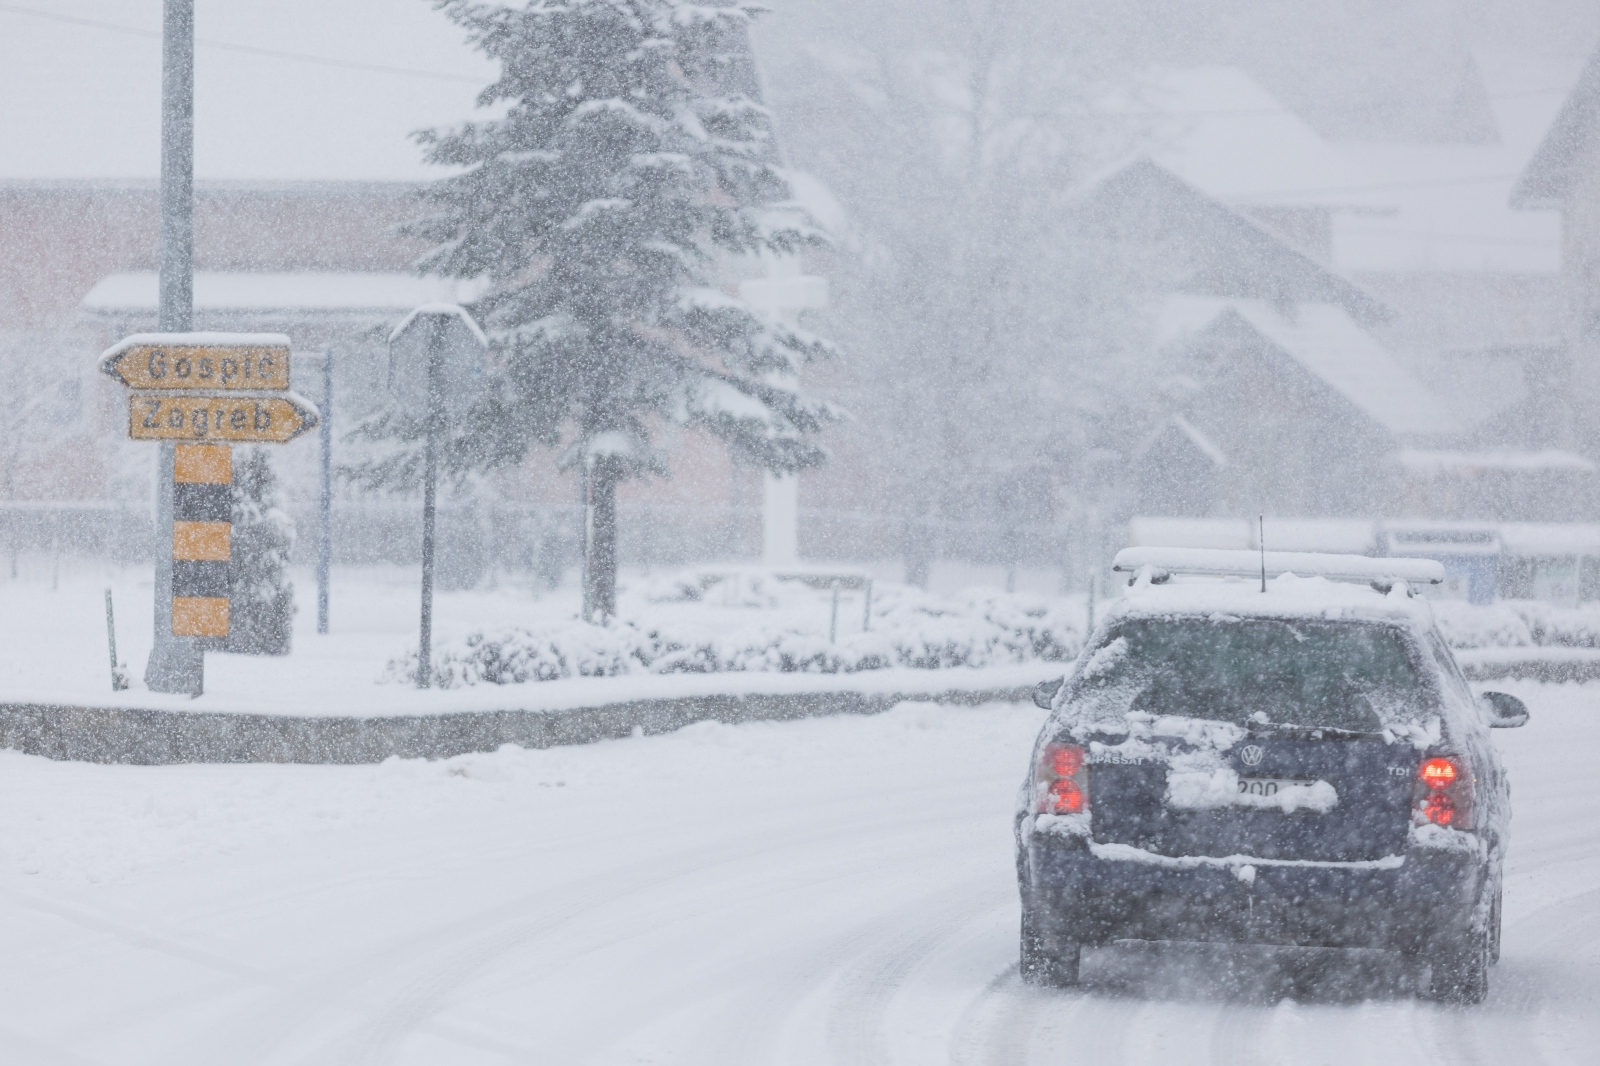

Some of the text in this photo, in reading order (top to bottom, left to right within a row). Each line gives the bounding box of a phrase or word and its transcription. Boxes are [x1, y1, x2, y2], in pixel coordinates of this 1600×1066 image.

[142, 399, 272, 437] Zagreb
[1096, 756, 1145, 766] PASSAT
[1241, 744, 1263, 766] VW
[1386, 766, 1410, 777] TDI
